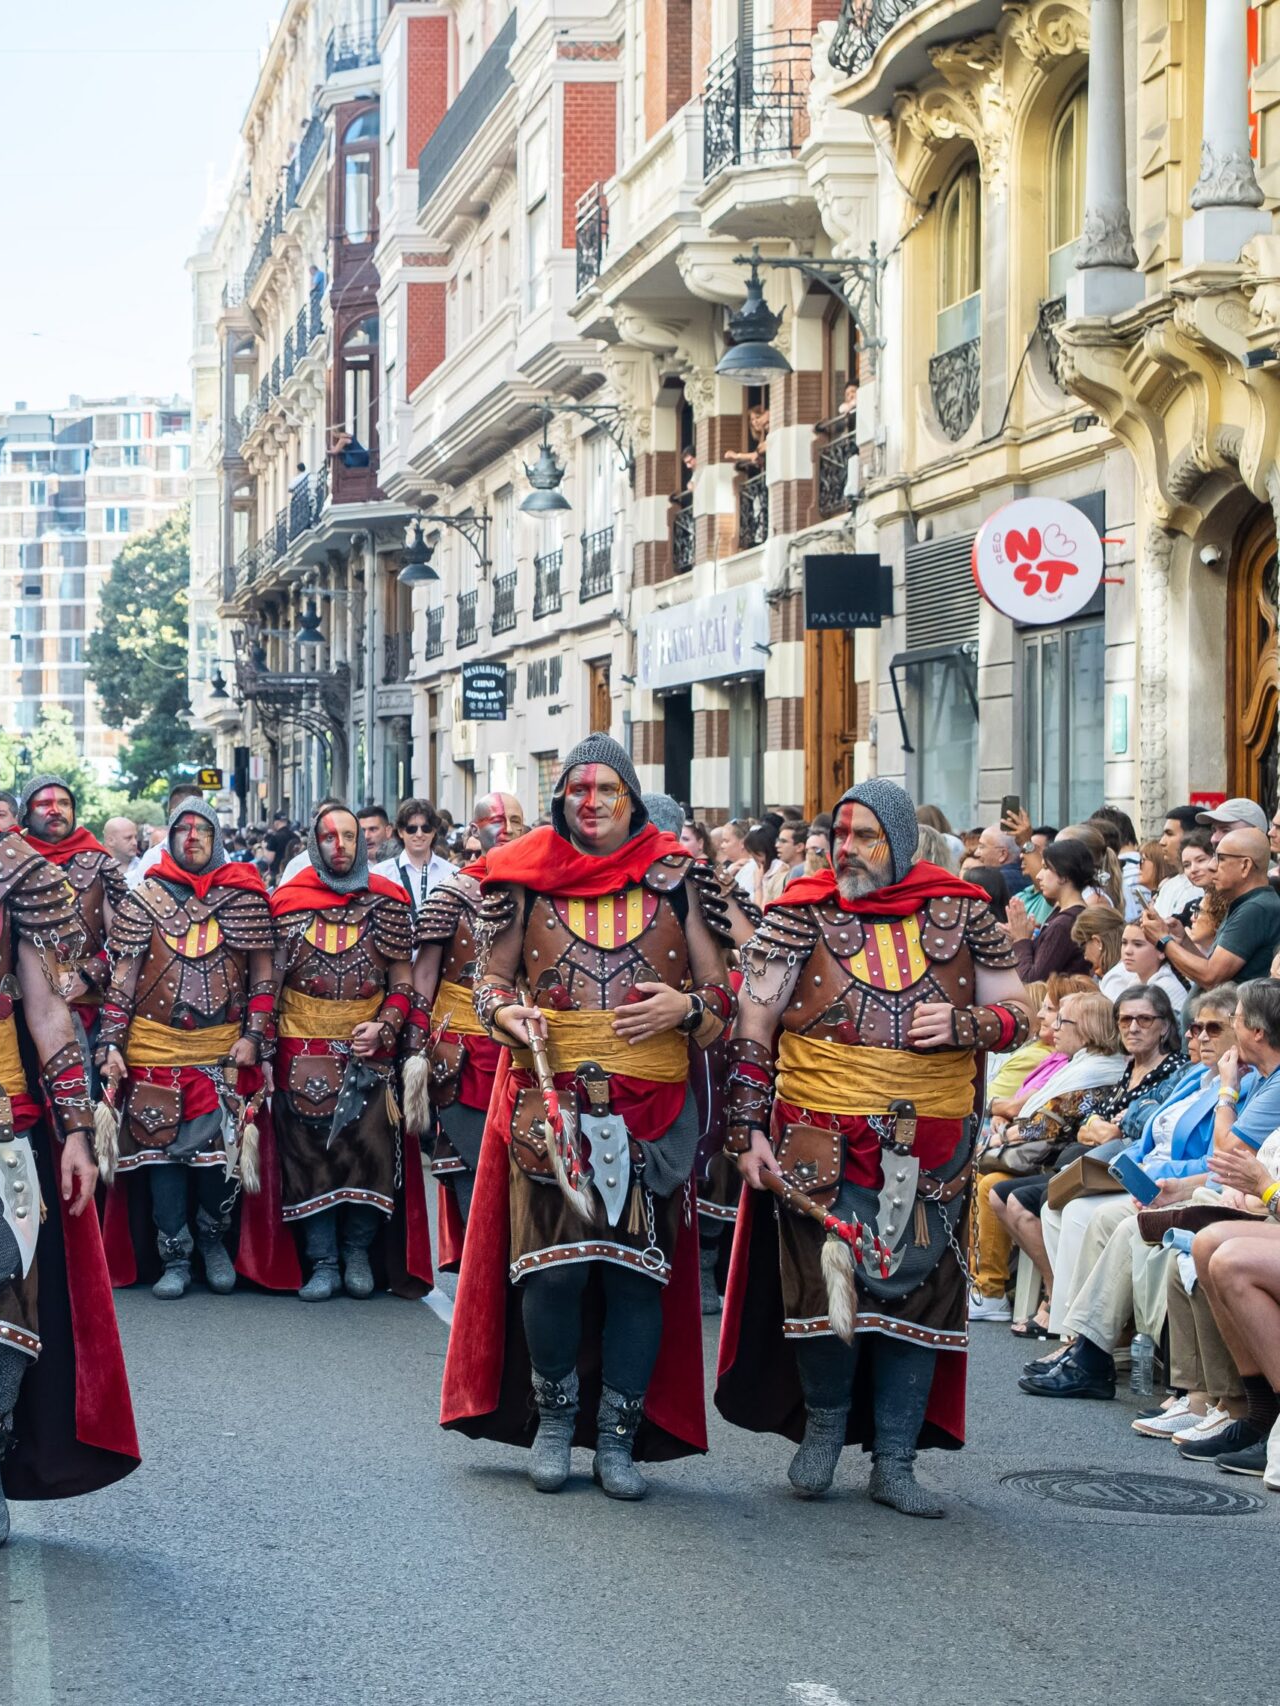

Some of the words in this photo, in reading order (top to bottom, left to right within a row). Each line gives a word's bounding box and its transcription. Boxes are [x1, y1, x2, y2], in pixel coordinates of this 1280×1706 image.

[811, 612, 877, 623] PASCUAL
[463, 664, 506, 678] RESTAURANTE
[472, 680, 496, 688] CHINO
